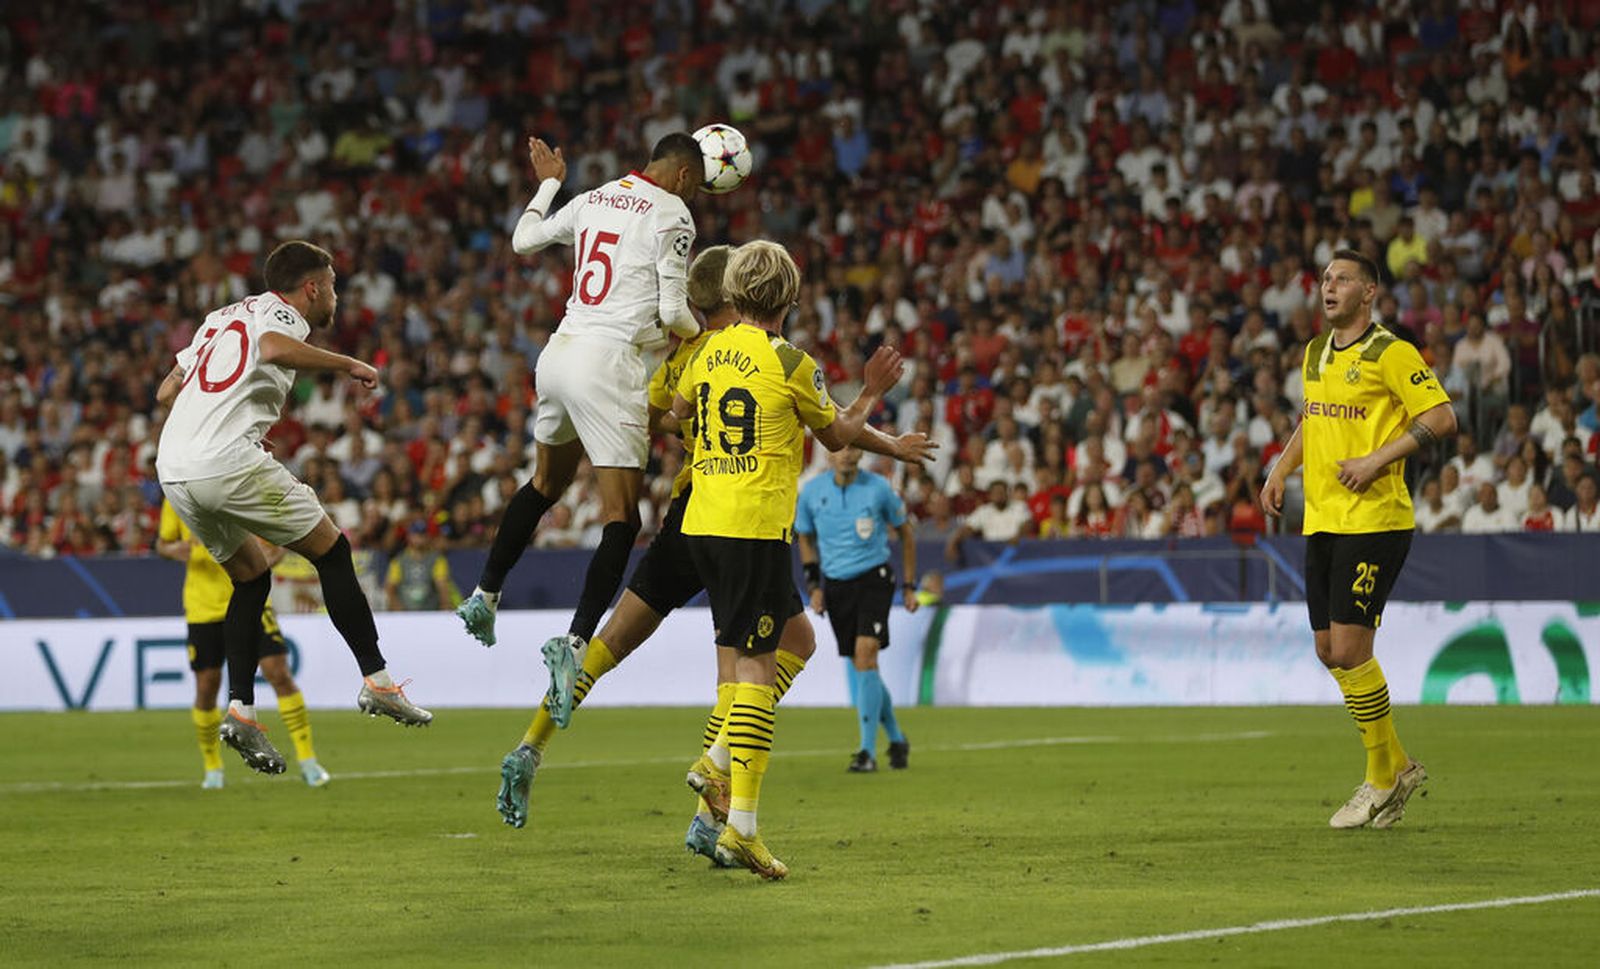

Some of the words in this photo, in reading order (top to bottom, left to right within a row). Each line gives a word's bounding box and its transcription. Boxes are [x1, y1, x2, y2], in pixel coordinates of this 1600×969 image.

[573, 227, 620, 306] 15
[706, 350, 760, 379] BRANDT
[699, 382, 757, 455] 19
[1309, 401, 1367, 420] EVONIK
[1352, 562, 1379, 594] 25
